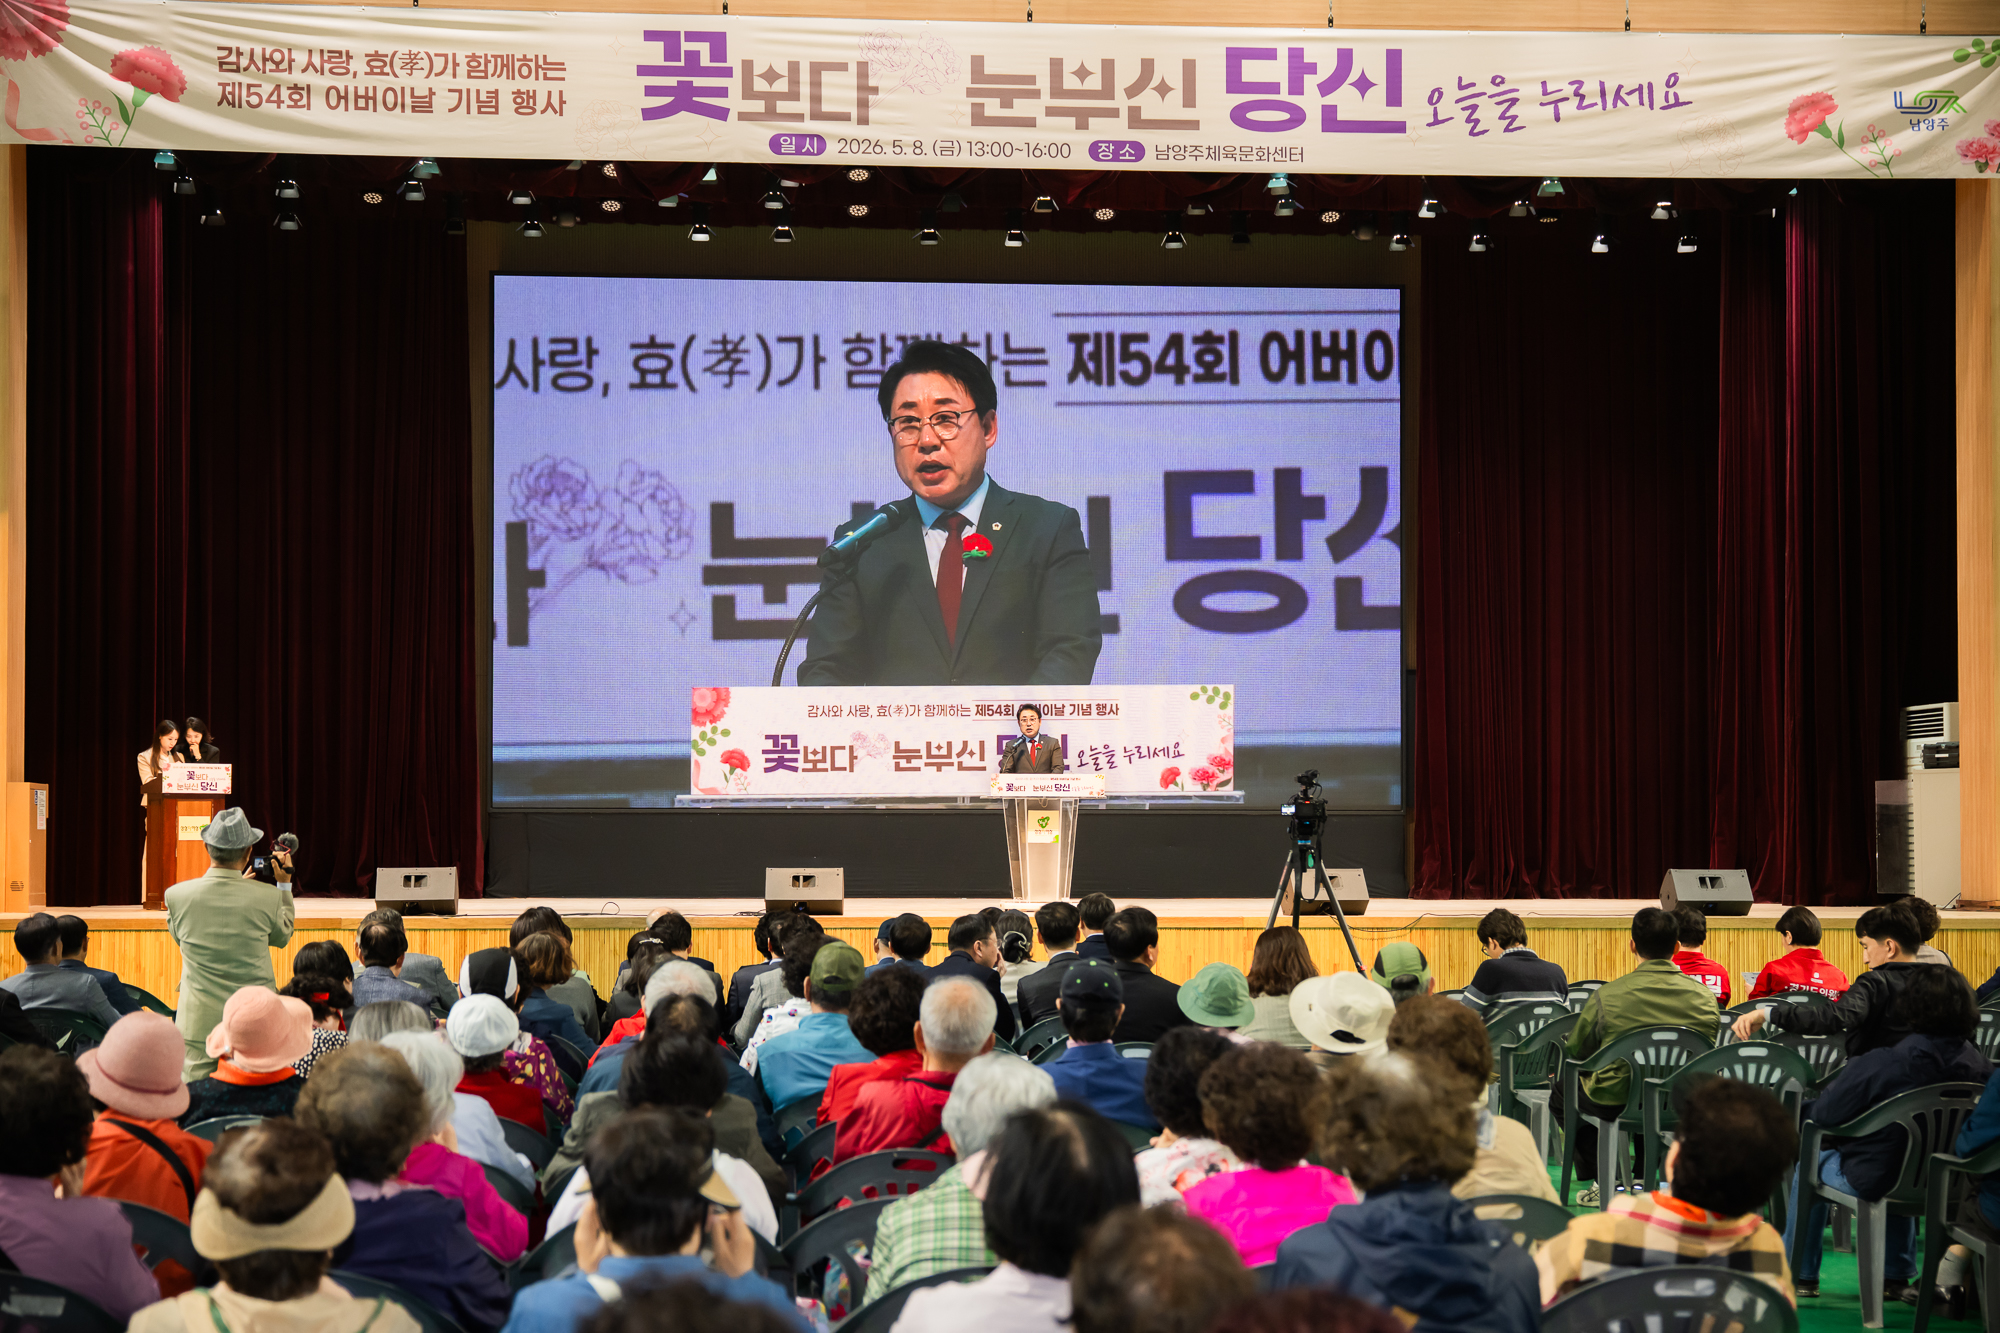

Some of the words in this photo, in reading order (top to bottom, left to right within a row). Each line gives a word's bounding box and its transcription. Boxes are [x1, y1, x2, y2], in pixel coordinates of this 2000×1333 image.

[216, 46, 296, 75] 감사와
[300, 48, 358, 79] 사랑,
[364, 49, 460, 79] 효(孝)가
[464, 52, 567, 82] 함께하는
[636, 29, 880, 126] 꽃보다
[965, 54, 1201, 131] 눈부신
[1225, 46, 1407, 134] 당신
[1426, 75, 1527, 137] 오늘을
[1539, 72, 1693, 122] 누리세요
[217, 81, 312, 111] 제54회
[325, 84, 437, 113] 어버이날
[447, 88, 500, 115] 기념
[511, 88, 567, 117] 행사
[1909, 117, 1950, 132] 남양주
[837, 138, 887, 155] 2026.
[892, 139, 907, 155] 5.
[912, 140, 928, 156] 8.
[932, 139, 962, 157] (금)
[966, 141, 1072, 159] 13:00~16:00
[1155, 144, 1304, 163] 남양주체육문화센터
[495, 334, 610, 398] 사랑,
[628, 333, 828, 393] 효(孝)가
[841, 332, 1049, 388] 함는
[1066, 329, 1240, 387] 제54회
[807, 704, 843, 718] 감사와
[846, 704, 874, 719] 사랑,
[876, 704, 921, 718] 효(孝)가
[924, 704, 971, 718] 함께하는
[974, 703, 1015, 717] 제54회
[1069, 703, 1092, 717] 기념
[1095, 703, 1120, 717] 행사
[761, 733, 858, 773] 꽃보다
[892, 740, 987, 772] 눈부신
[1077, 744, 1118, 771] 오늘을
[1122, 742, 1185, 765] 누리세요
[187, 771, 208, 780] 꽃보다
[201, 782, 217, 791] 당신
[1054, 783, 1071, 792] 당신
